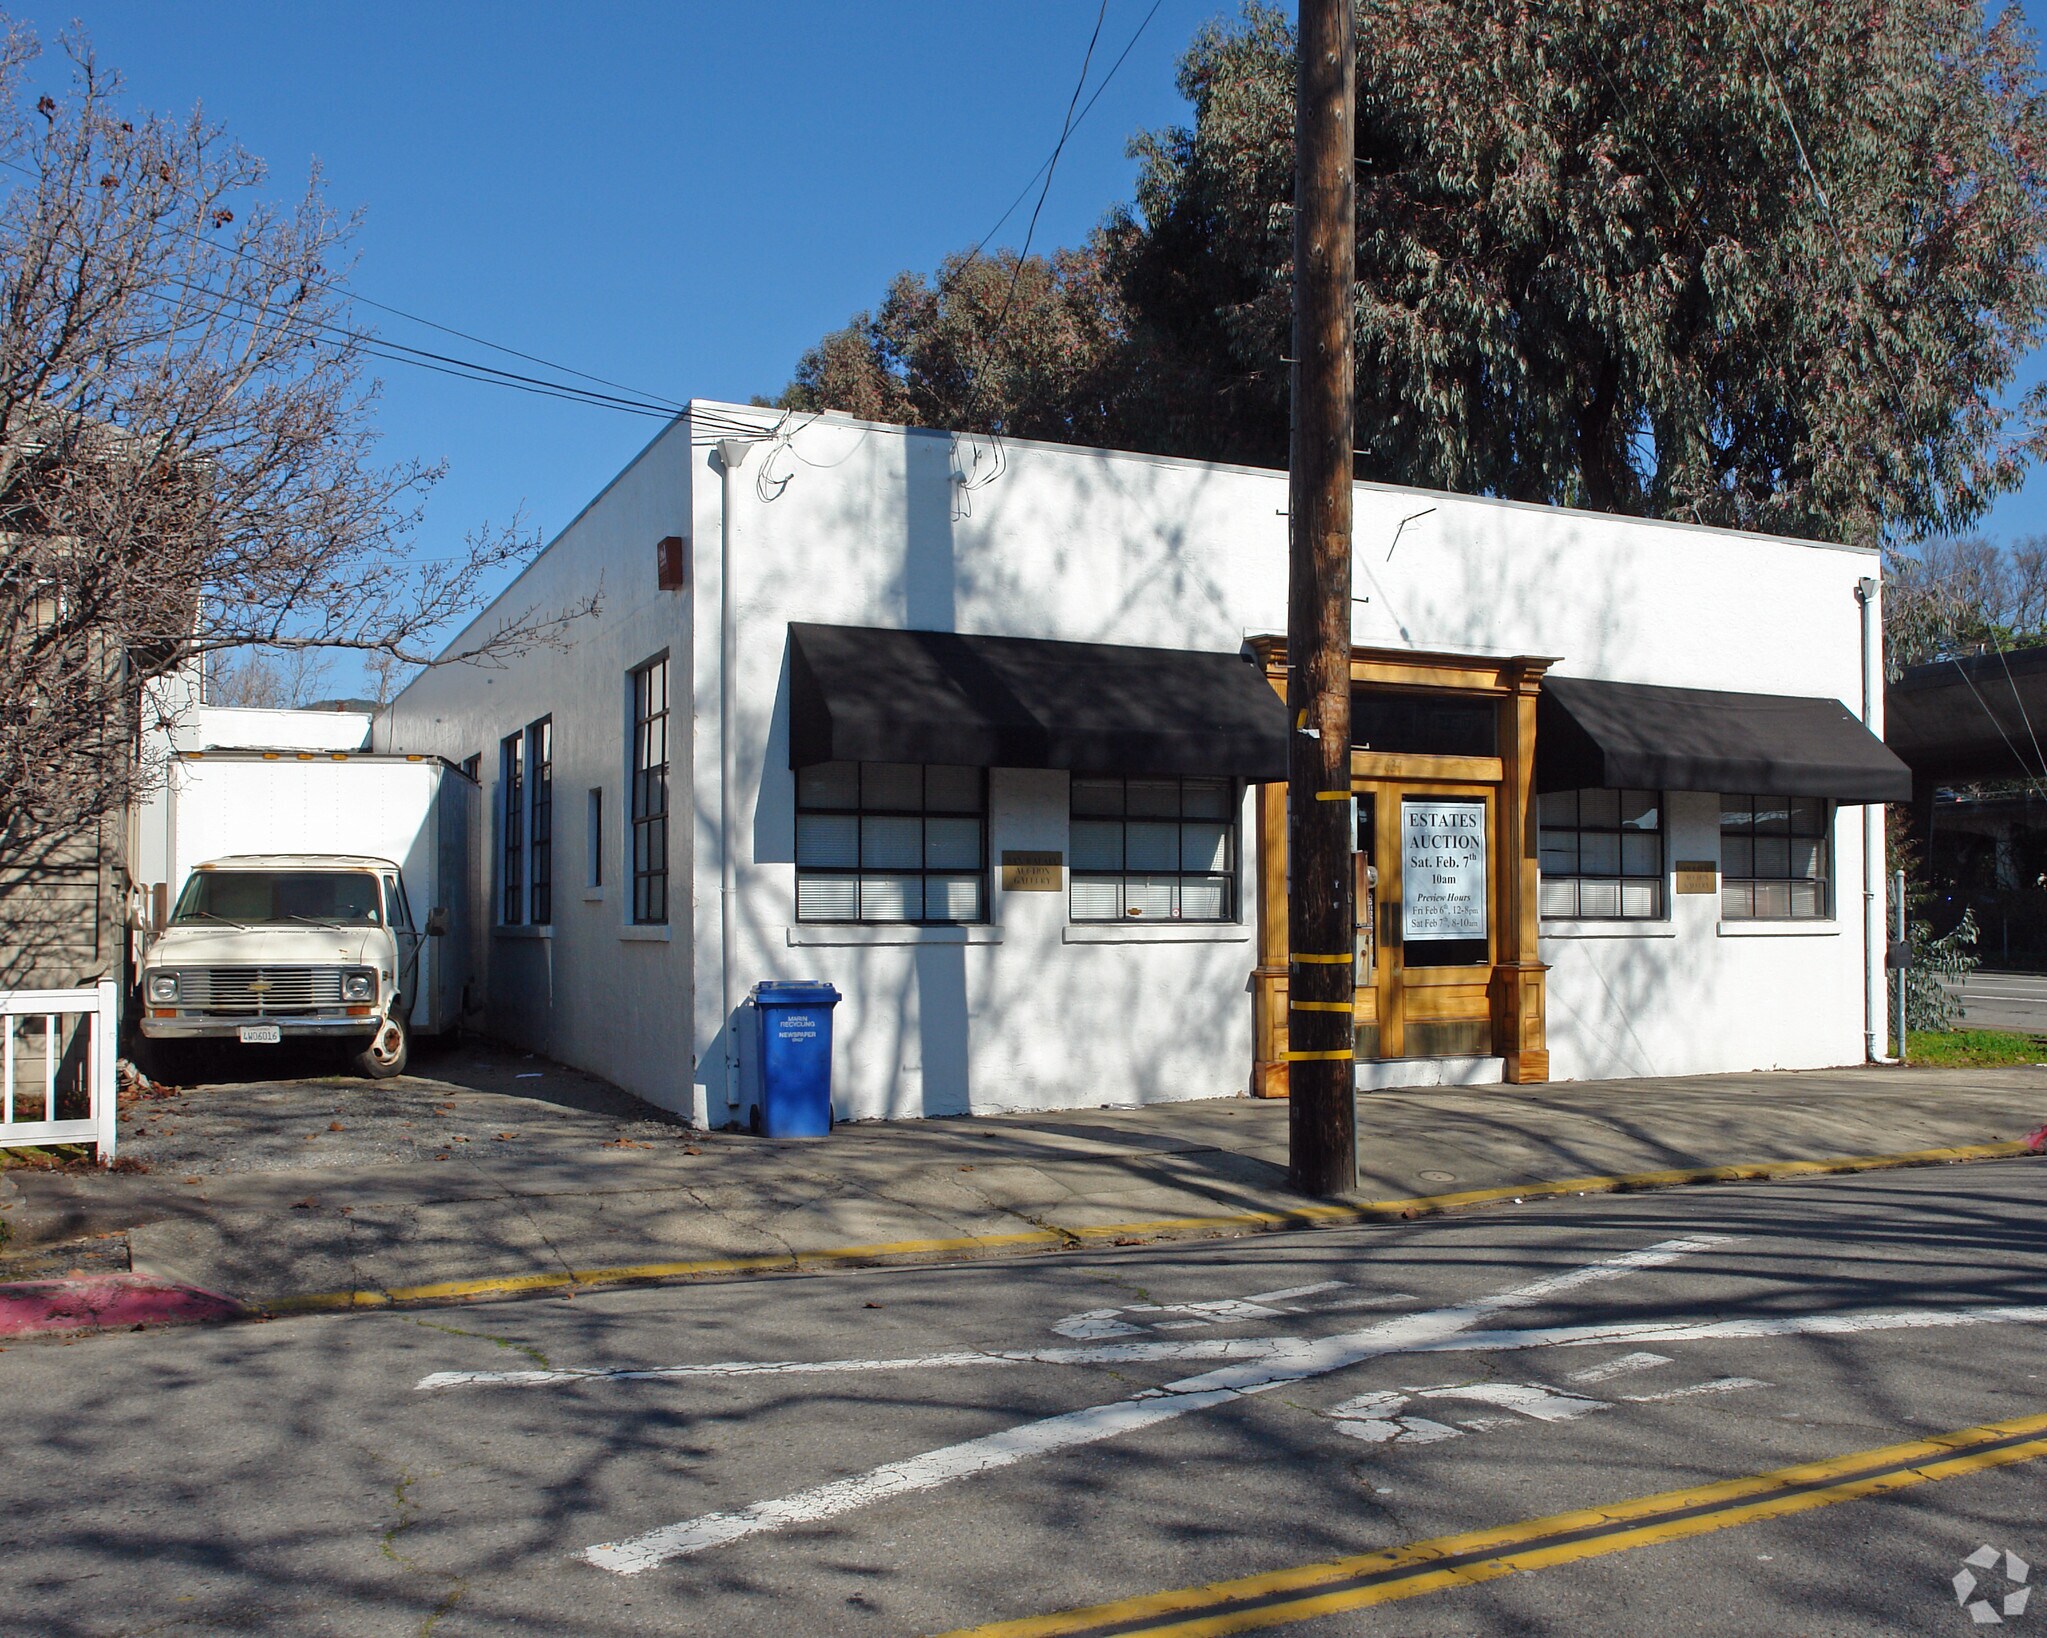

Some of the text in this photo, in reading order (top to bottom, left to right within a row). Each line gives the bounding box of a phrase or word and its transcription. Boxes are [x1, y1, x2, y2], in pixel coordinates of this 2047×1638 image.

[1409, 813, 1477, 828] ESTATES
[1409, 834, 1480, 849] AUCTION
[1410, 852, 1477, 868] Sat. Feb. 7th
[1432, 873, 1456, 885] 10am
[1417, 892, 1471, 902] Preview Hours
[1412, 905, 1424, 915] Fri
[1425, 905, 1438, 915] Feb
[1411, 918, 1423, 928] Sat
[1424, 918, 1438, 928] Feb
